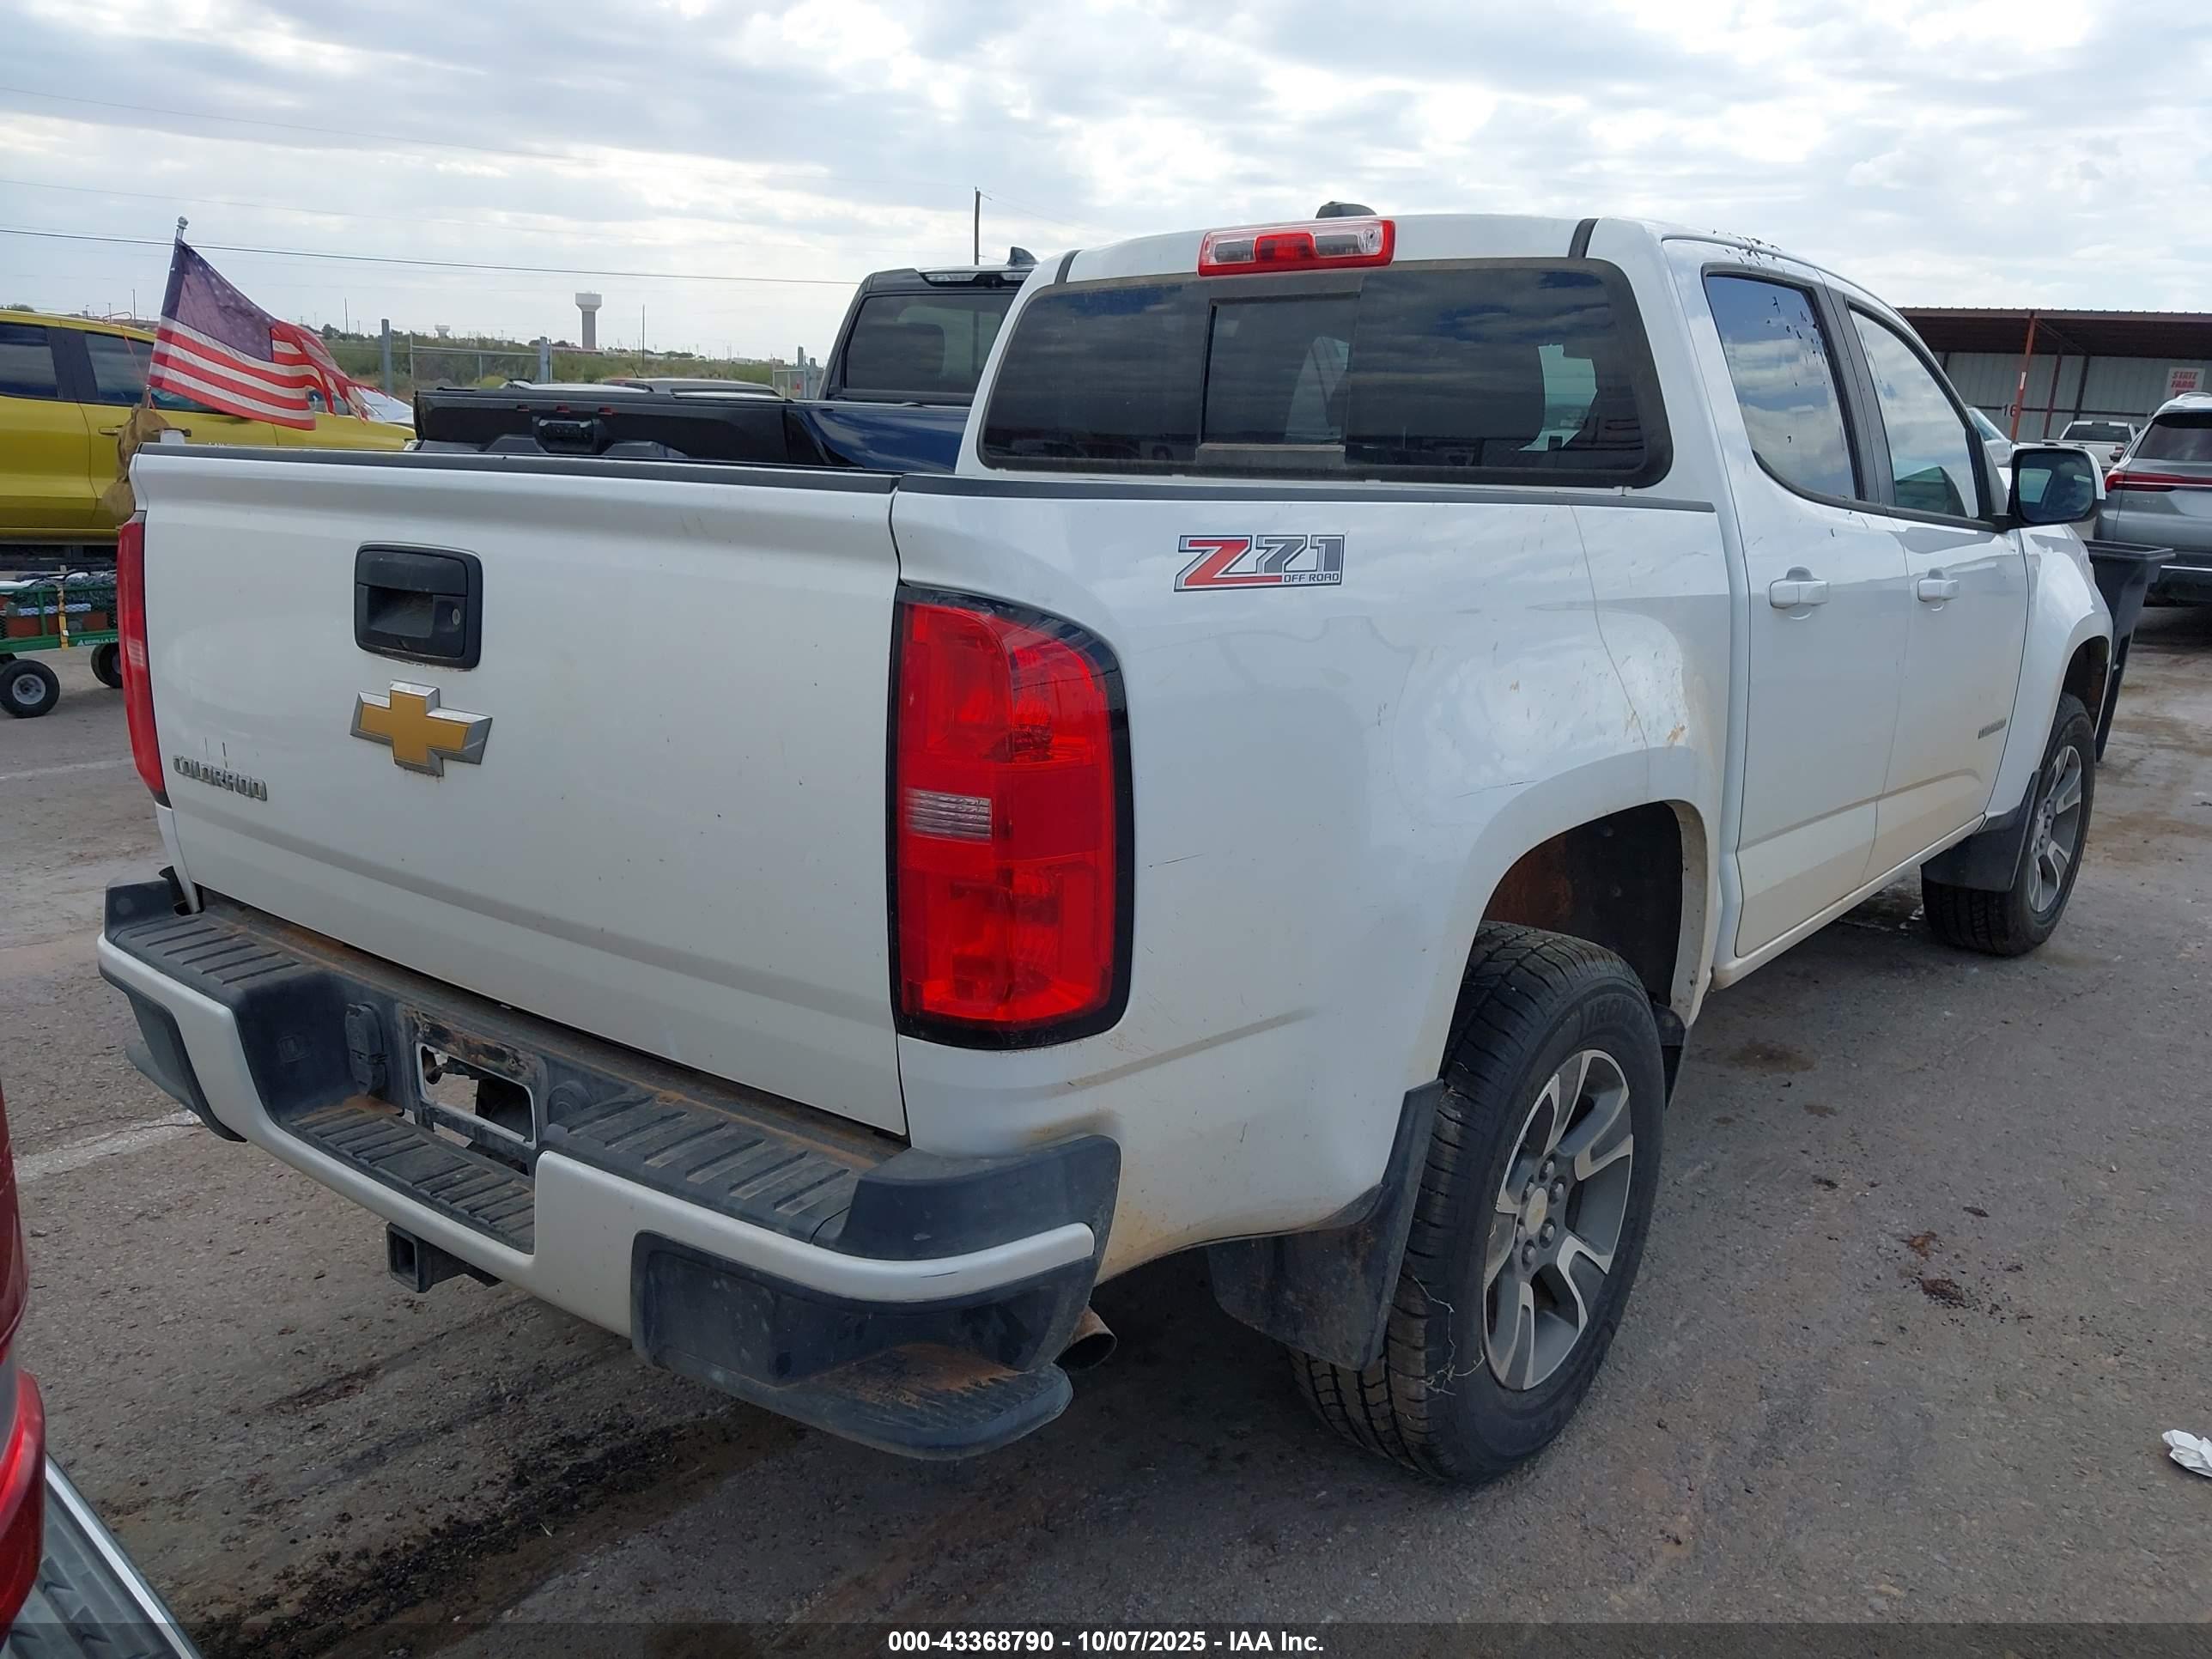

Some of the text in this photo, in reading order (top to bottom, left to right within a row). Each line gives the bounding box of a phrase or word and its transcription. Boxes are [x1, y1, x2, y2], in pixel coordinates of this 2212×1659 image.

[2172, 371, 2199, 380] STATE
[1174, 534, 1346, 592] Z71
[1284, 573, 1340, 583] OFF ROAD
[173, 756, 267, 802] COLORADO
